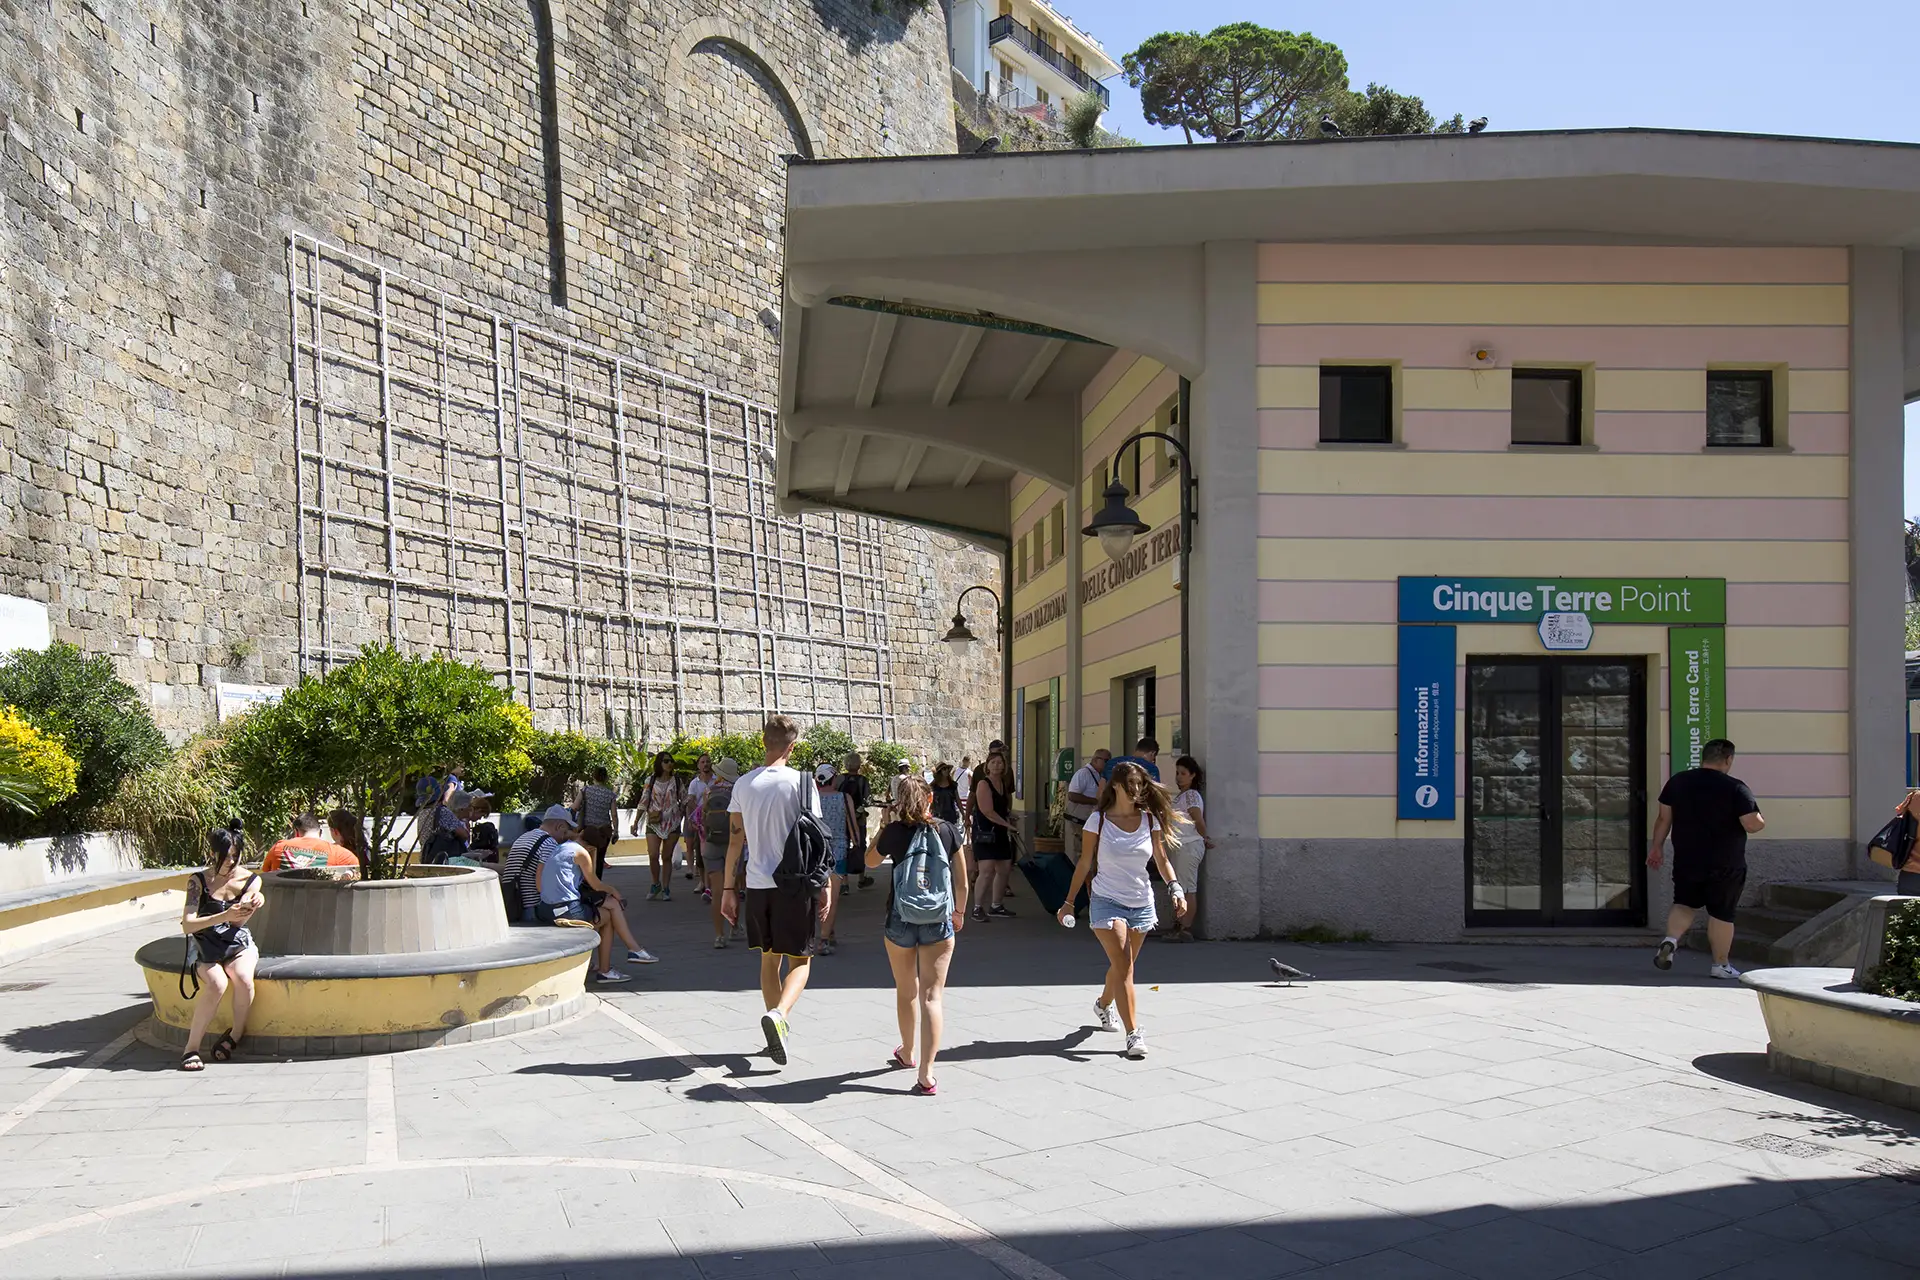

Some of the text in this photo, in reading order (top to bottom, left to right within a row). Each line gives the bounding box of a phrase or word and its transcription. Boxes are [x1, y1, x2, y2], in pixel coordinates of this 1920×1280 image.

[1082, 569, 1107, 605] DELLE
[1108, 542, 1149, 590] CINQUE
[1150, 523, 1181, 566] TERR
[1433, 583, 1692, 618] Cinque Terre Point
[1685, 650, 1699, 684] Card
[1686, 687, 1700, 725] Terre
[1414, 686, 1429, 777] Informazioni
[1432, 741, 1440, 777] Information
